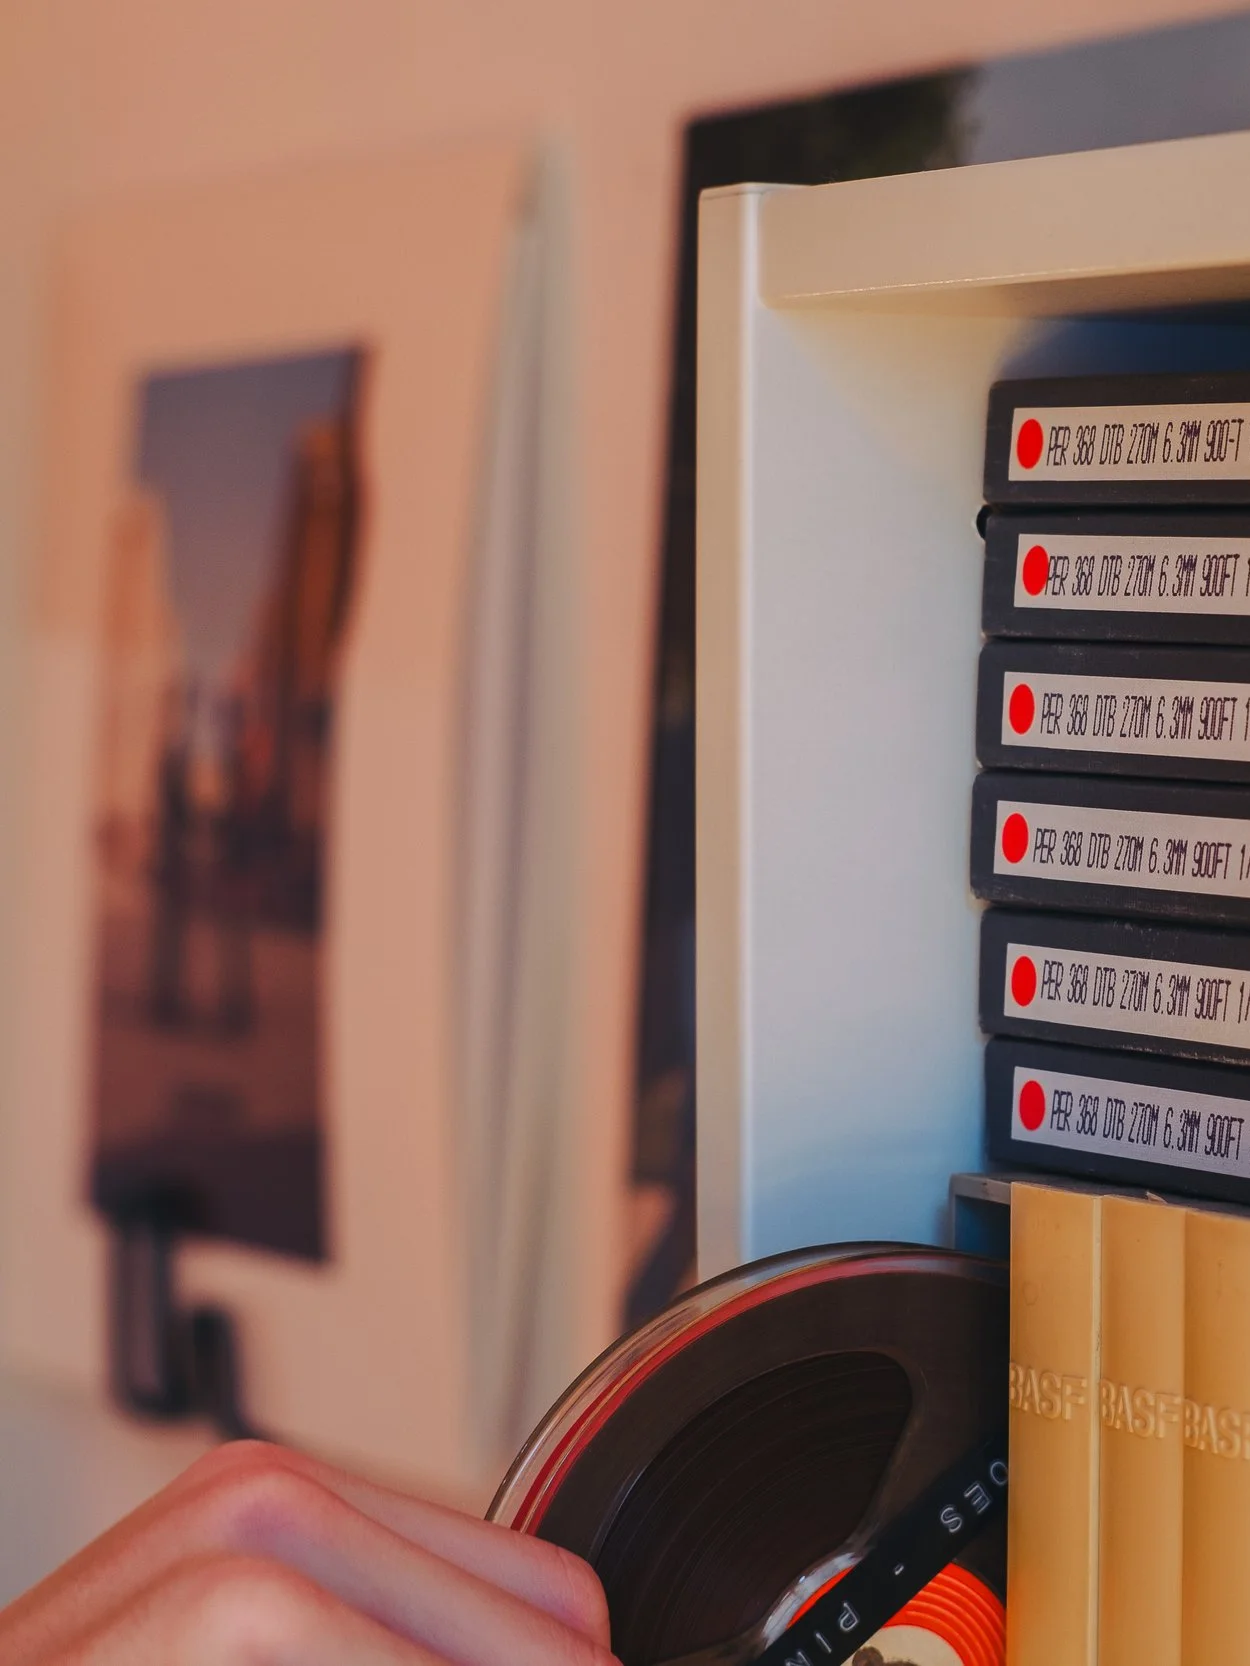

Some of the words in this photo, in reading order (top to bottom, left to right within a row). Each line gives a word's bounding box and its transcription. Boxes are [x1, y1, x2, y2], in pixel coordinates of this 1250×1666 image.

[1047, 426, 1071, 465] PER
[1073, 425, 1096, 464] 368
[1100, 425, 1124, 464] DTB
[1127, 422, 1159, 464] 270M
[1045, 556, 1070, 596] PER
[1072, 556, 1094, 596] 368
[1098, 555, 1122, 596] DTB
[1125, 555, 1156, 596] 270M
[1200, 554, 1240, 597] 900FT
[1040, 693, 1063, 734] PER
[1067, 694, 1088, 735] 368
[1093, 695, 1117, 737] DTB
[1120, 696, 1152, 738] 270M
[1198, 697, 1238, 740] 900FT
[1033, 828, 1056, 864] PER
[1060, 831, 1082, 866] 368
[1087, 833, 1111, 869] DTB
[1114, 836, 1143, 872] 270M
[1192, 841, 1232, 879] 900FT
[1041, 960, 1064, 1001] PER
[1068, 963, 1089, 1002] 368
[1093, 966, 1116, 1007] DTB
[1120, 970, 1149, 1012] 270M
[1195, 978, 1231, 1021] 900FT
[1050, 1090, 1073, 1131] PER
[1077, 1094, 1099, 1135] 368
[1103, 1097, 1125, 1140] DTB
[1128, 1103, 1158, 1146] 270M
[1205, 1114, 1244, 1160] 900FT
[1010, 1362, 1088, 1420] BASF
[1101, 1378, 1181, 1438] BASF
